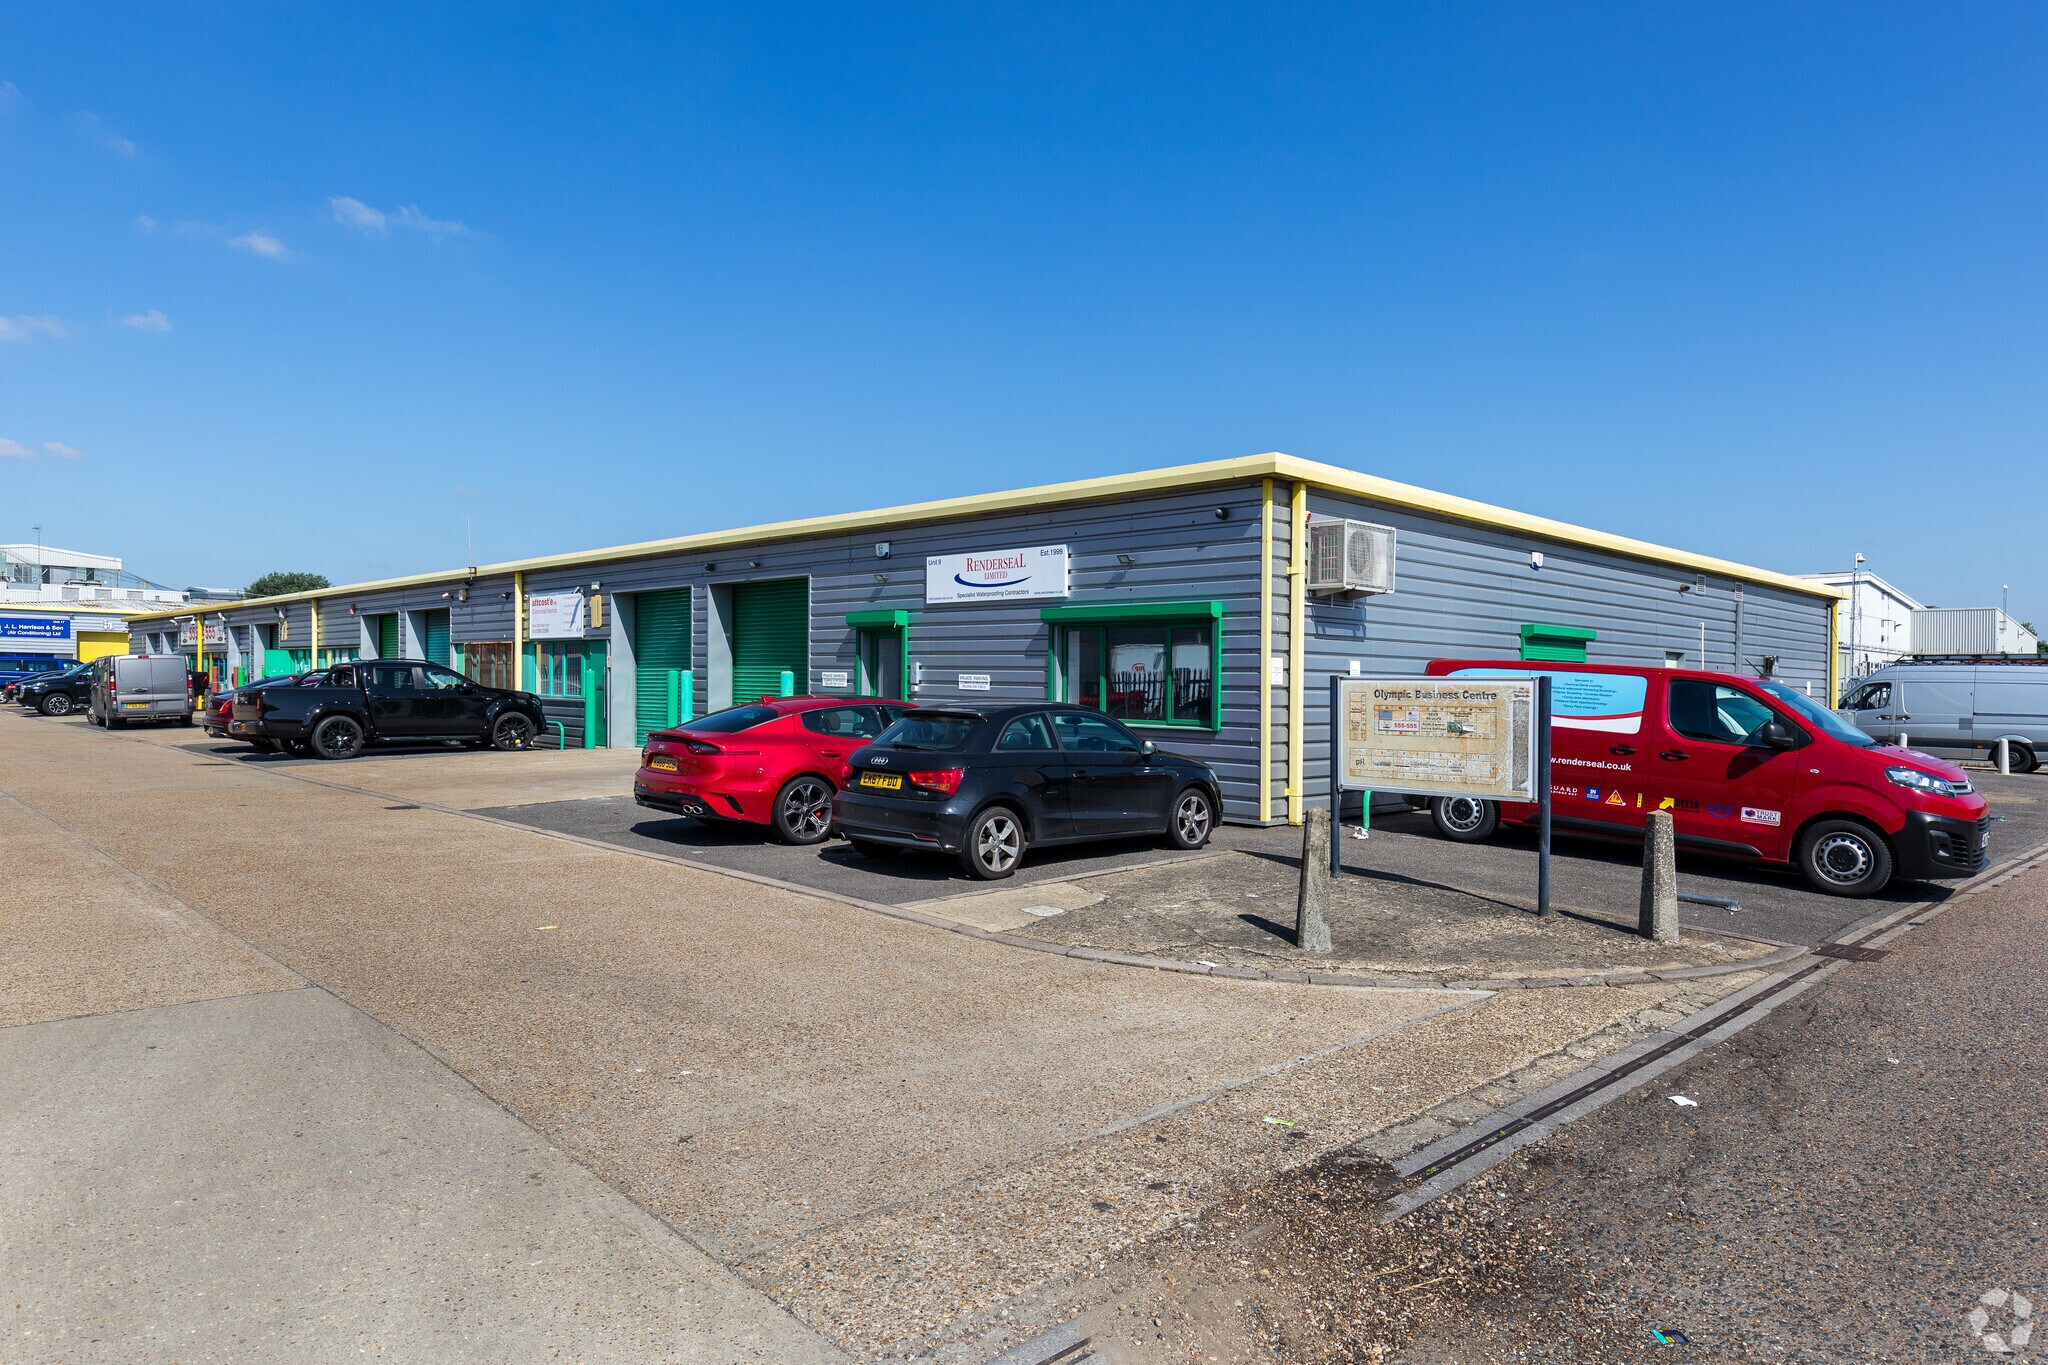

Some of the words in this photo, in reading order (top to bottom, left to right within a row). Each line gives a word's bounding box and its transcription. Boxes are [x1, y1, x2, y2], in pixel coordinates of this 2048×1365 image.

[1040, 548, 1064, 556] Est.1999
[966, 554, 1026, 572] RENDERSEAL
[984, 571, 1008, 580] LIMITED
[1374, 690, 1412, 701] Olympic
[1415, 690, 1459, 700] Business
[1462, 690, 1496, 699] Centre
[1675, 799, 1699, 809] DELTA
